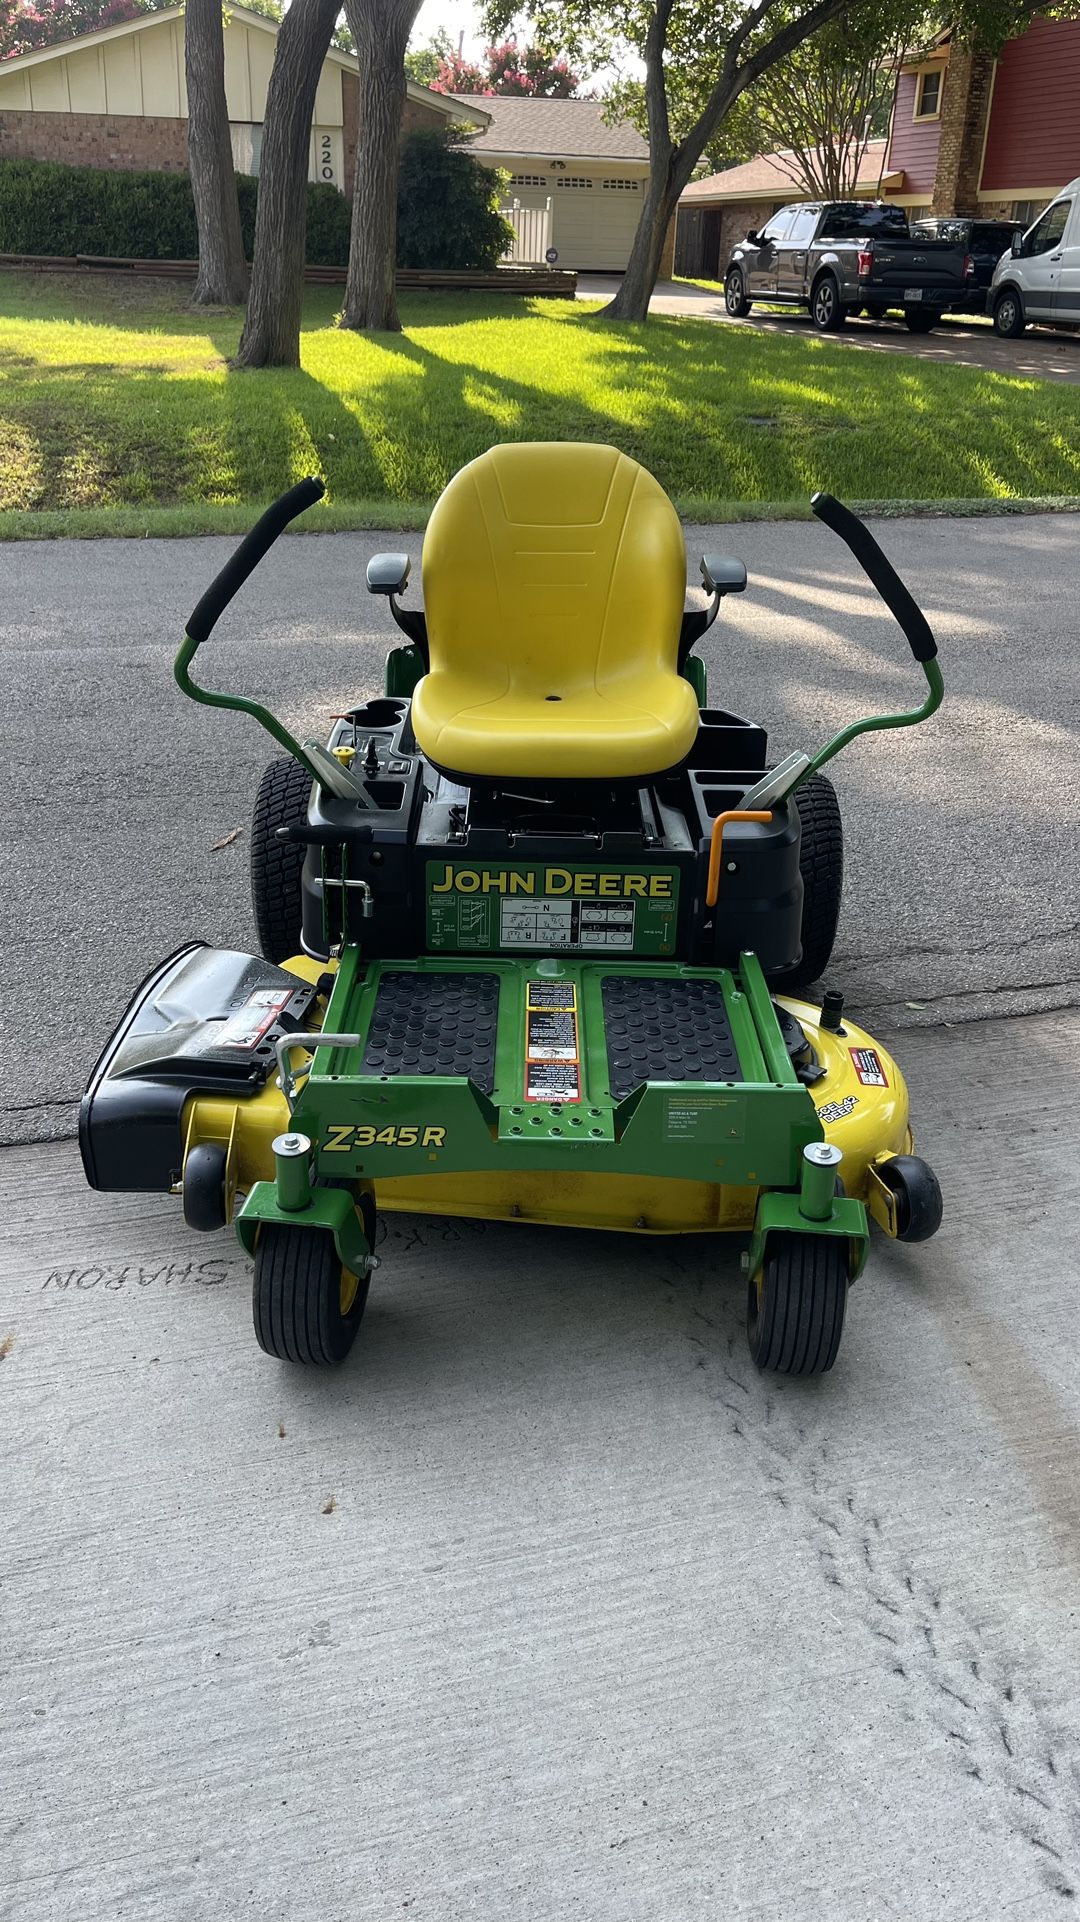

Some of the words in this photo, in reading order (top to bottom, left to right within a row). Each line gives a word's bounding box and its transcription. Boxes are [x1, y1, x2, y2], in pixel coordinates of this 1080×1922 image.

[322, 135, 333, 179] 220
[432, 864, 536, 895] JOHN
[543, 867, 675, 898] DEERE
[543, 904, 550, 912] N
[525, 931, 532, 939] R
[843, 1095, 860, 1106] 42
[822, 1104, 854, 1123] DEEP
[322, 1125, 448, 1151] Z345R
[41, 1259, 234, 1290] SHARON
